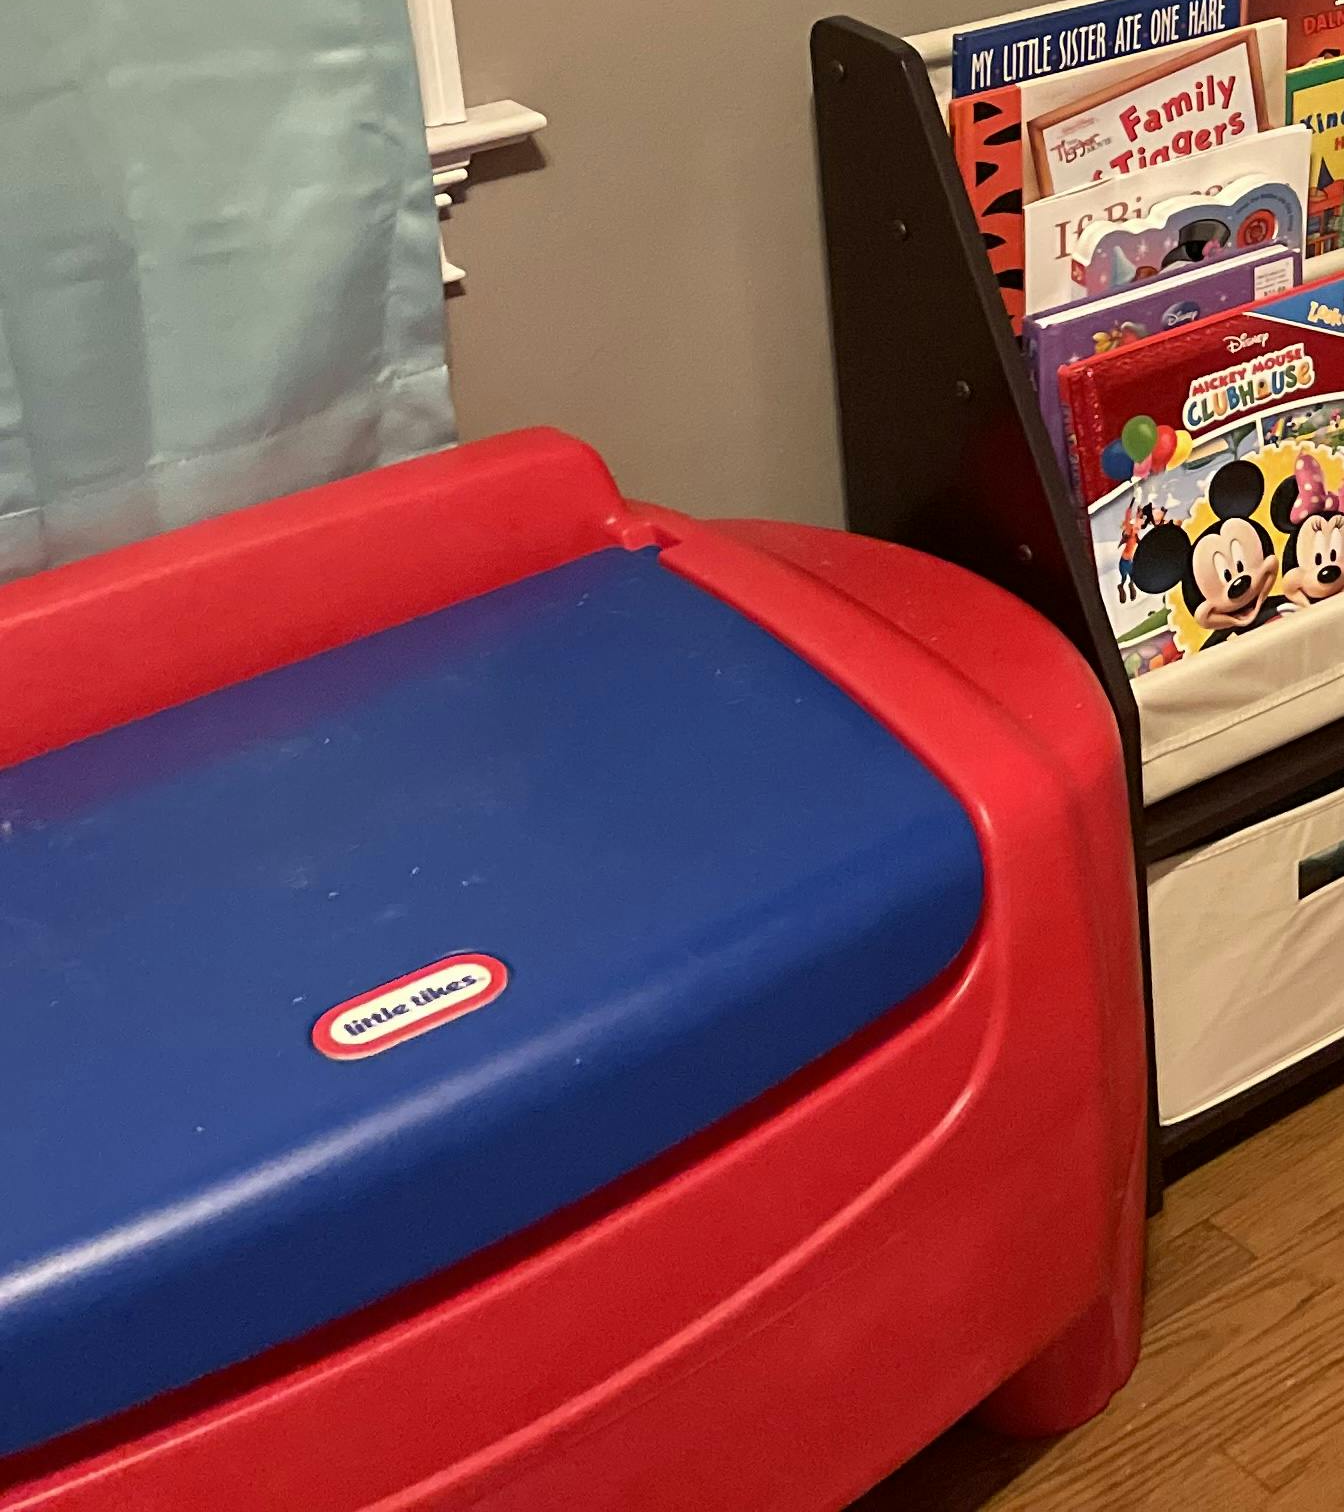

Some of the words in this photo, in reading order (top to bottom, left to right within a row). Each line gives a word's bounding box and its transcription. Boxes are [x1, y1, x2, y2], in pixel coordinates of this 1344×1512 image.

[971, 48, 994, 90] MY
[1003, 35, 1052, 82] LITTLE
[1058, 22, 1106, 70] SISTER
[1114, 13, 1142, 55] ATE
[1150, 4, 1181, 45] ONE
[1119, 74, 1236, 142] Family
[1192, 368, 1246, 396] MICKEY
[1252, 348, 1303, 374] MOUSE
[1223, 333, 1270, 354] Disney
[343, 1002, 410, 1036] little
[411, 975, 478, 1007] tikes
